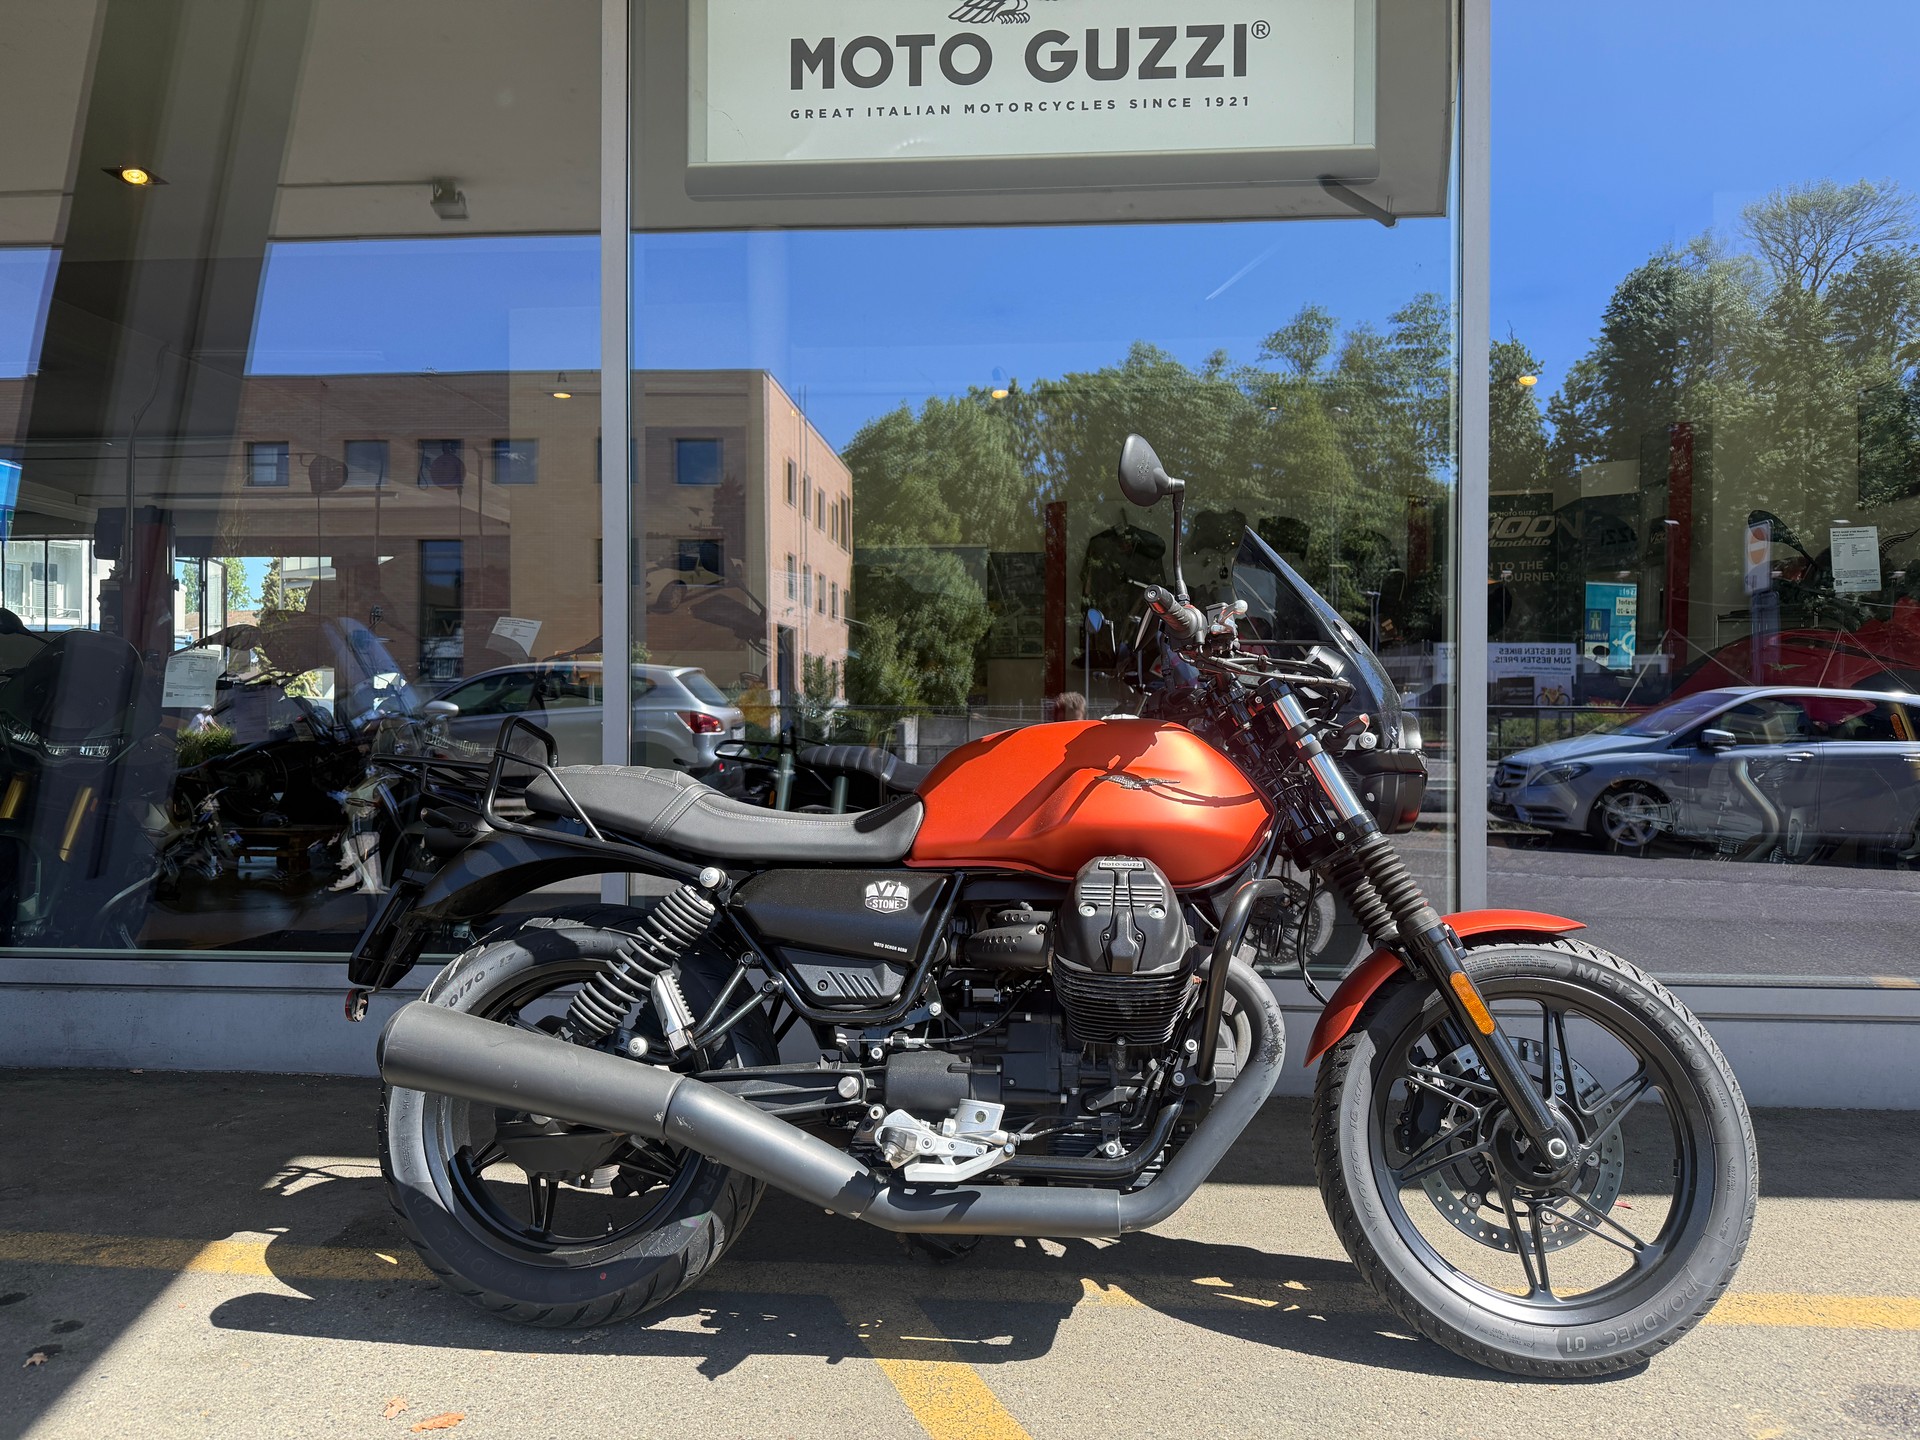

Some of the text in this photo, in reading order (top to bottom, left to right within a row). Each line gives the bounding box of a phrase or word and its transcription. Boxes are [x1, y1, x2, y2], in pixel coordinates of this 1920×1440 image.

[790, 32, 993, 90] MOTO
[790, 96, 1249, 119] GREAT ITALIAN MOTORCYCLES SINCE 1921
[1497, 561, 1515, 571] TO
[1519, 560, 1544, 570] THE
[1500, 571, 1559, 582] JOURNEY
[874, 880, 901, 898] V7
[872, 899, 900, 909] STONE
[443, 970, 486, 1009] 0/70
[1575, 962, 1696, 1055] METZELER
[1603, 1279, 1699, 1348] ROADTEC
[1565, 1336, 1587, 1353] 01
